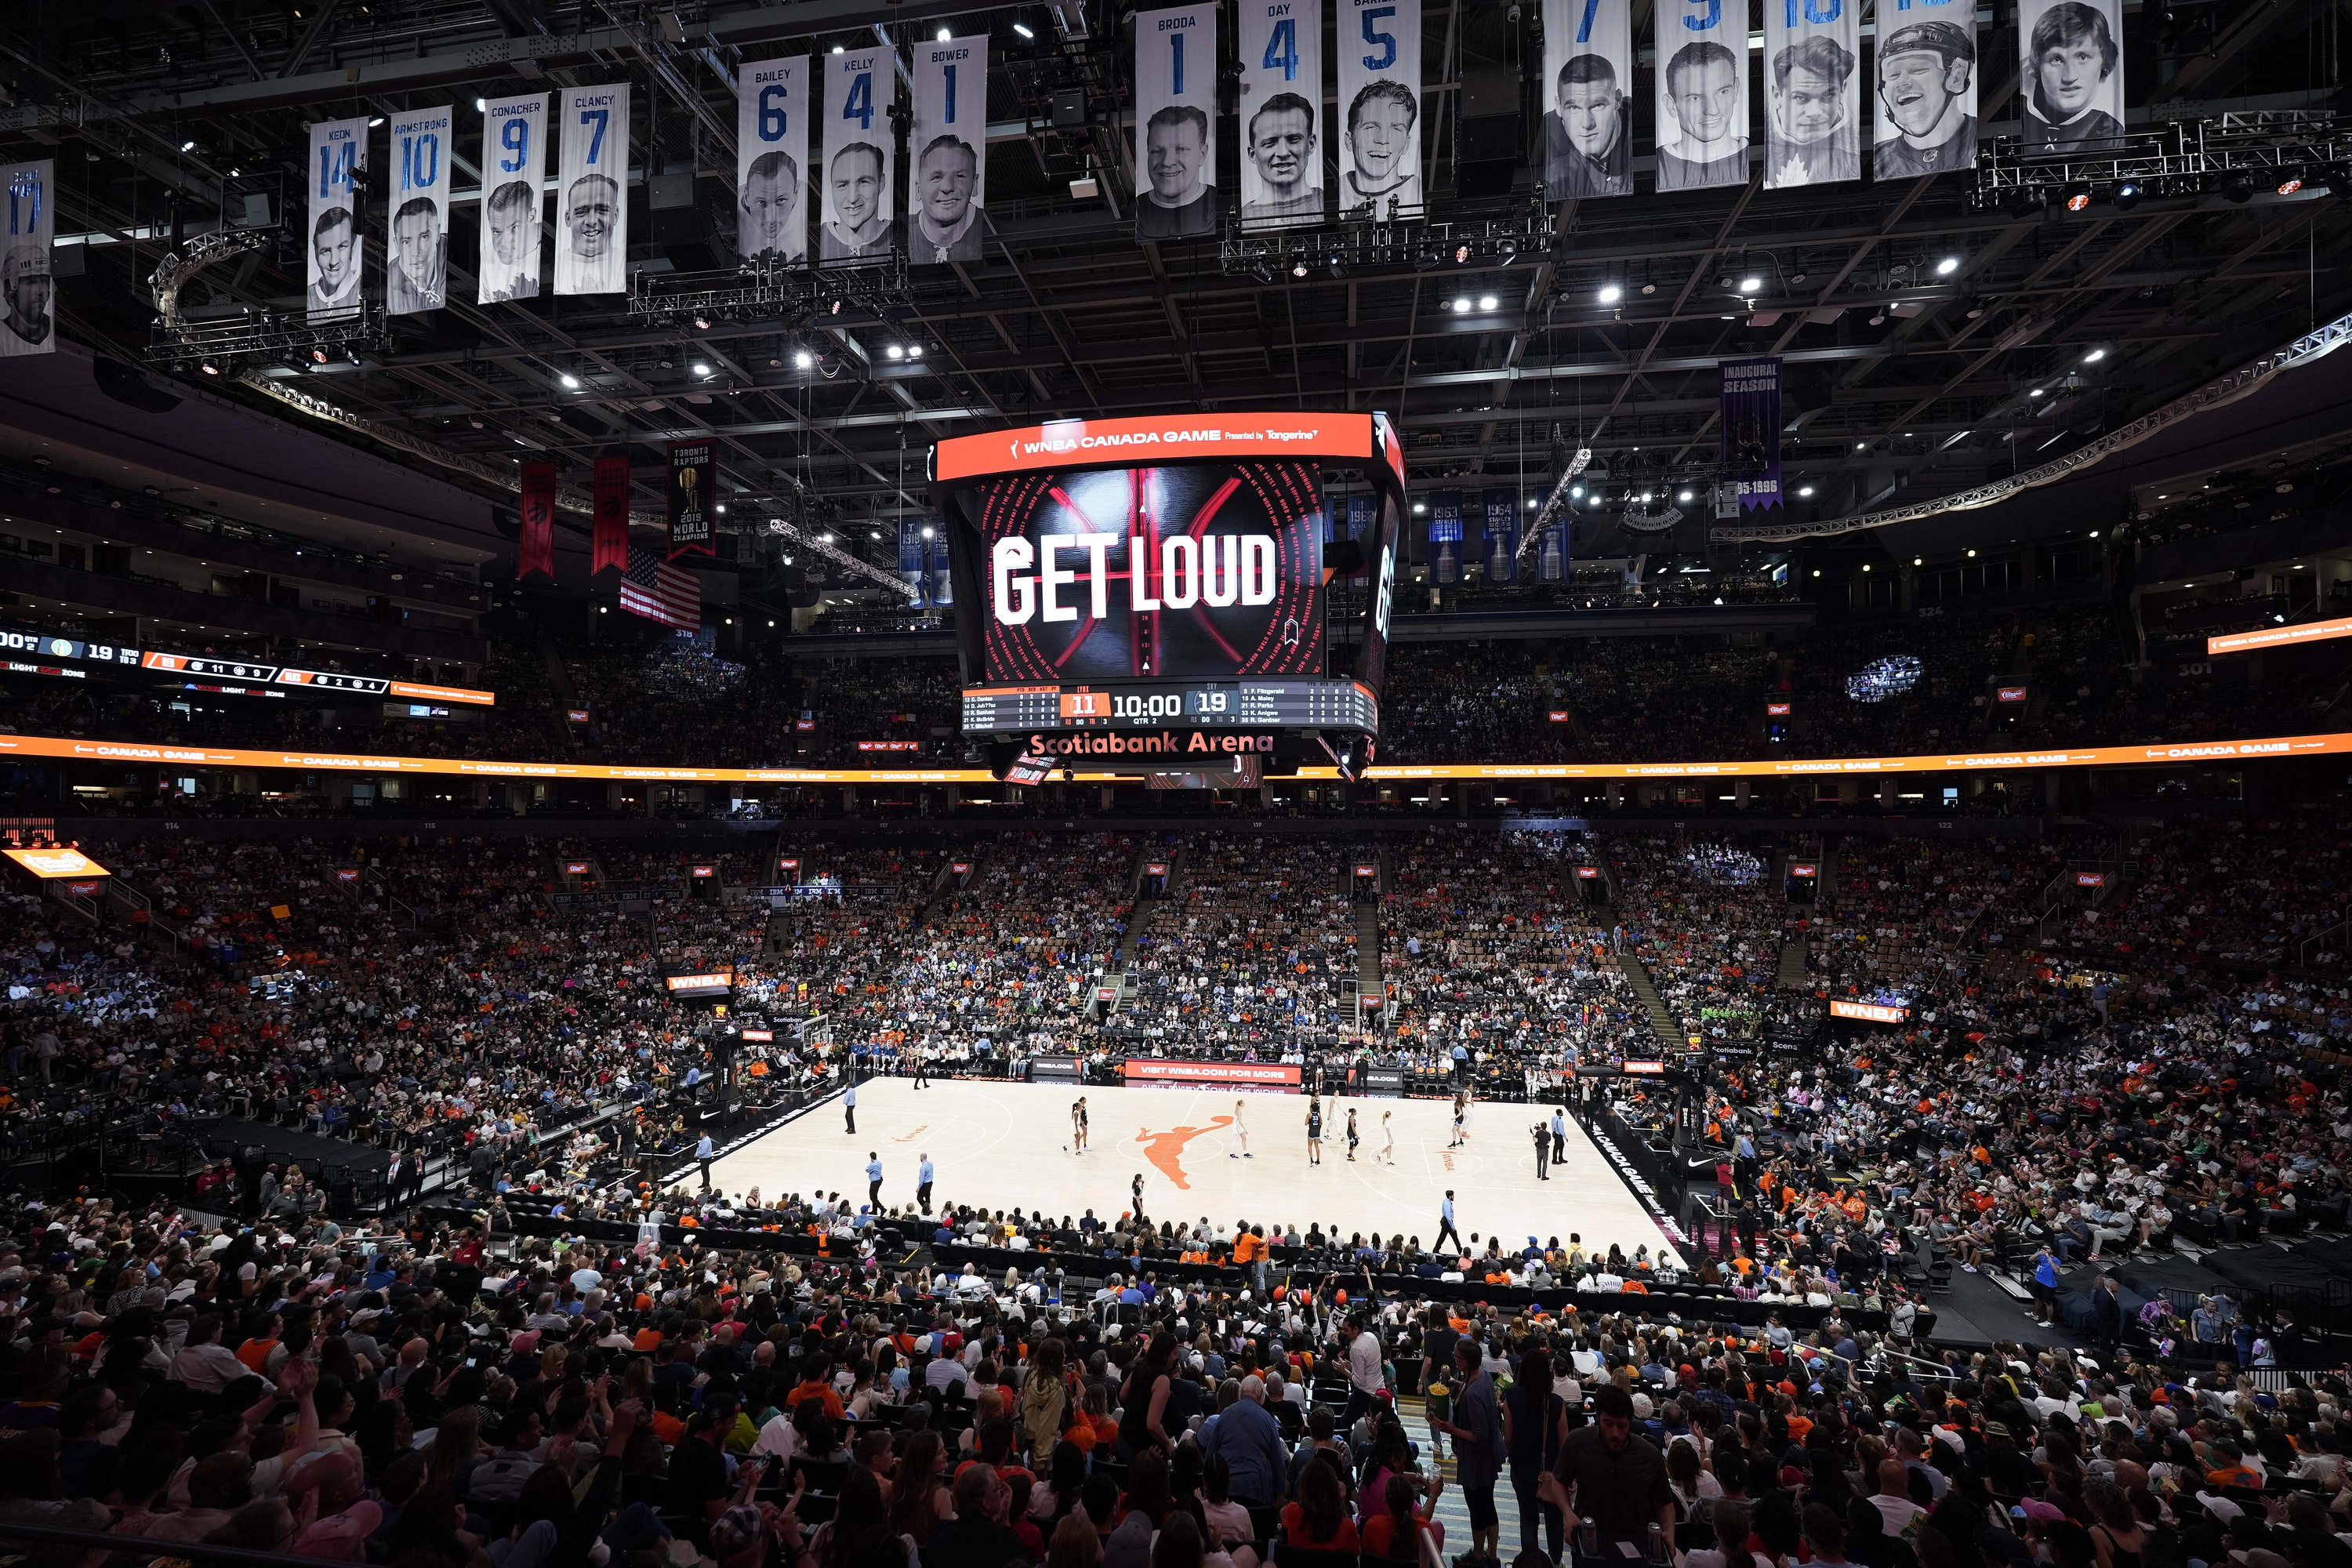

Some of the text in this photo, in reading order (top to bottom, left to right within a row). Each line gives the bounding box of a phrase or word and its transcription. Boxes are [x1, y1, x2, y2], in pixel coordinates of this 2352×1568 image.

[1268, 4, 1291, 18] DAY
[1158, 16, 1196, 31] BRODA
[1362, 6, 1396, 71] 5
[931, 49, 969, 63] BOWER
[1262, 18, 1299, 82] 4
[844, 57, 874, 72] KELLY
[1171, 33, 1184, 95] 1
[756, 69, 791, 83] BAILEY
[575, 94, 615, 108] CLANCY
[843, 72, 873, 130] 4
[943, 64, 956, 124] 1
[492, 102, 541, 118] CONACHER
[758, 84, 787, 142] 6
[394, 118, 448, 135] ARMSTRONG
[328, 129, 350, 141] KEON
[580, 109, 609, 165] 7
[500, 118, 528, 172] 9
[320, 141, 356, 198] 14
[401, 133, 439, 191] 10
[9, 181, 42, 235] 17
[1724, 364, 1777, 379] INAUGURAL
[1724, 379, 1777, 393] SEASON
[1024, 430, 1313, 454] WNBA CANADA GAME Presented by Tangerine
[674, 447, 708, 457] TORONTO
[673, 456, 709, 466] RAPTORS
[1434, 506, 1457, 519] 1963
[1487, 503, 1512, 516] 1964
[681, 513, 702, 523] 2019
[673, 521, 708, 535] WORLD
[673, 532, 709, 542] CHAMPIONS
[993, 532, 1119, 626] GET
[1130, 534, 1276, 612] LOUD
[2219, 628, 2322, 648] WNBA CANADA GAME
[89, 644, 113, 660] 19
[9, 662, 86, 678] LIGHT ZONE
[212, 664, 223, 673] 11
[2178, 662, 2212, 677] 301
[1073, 695, 1095, 714] 11
[1114, 695, 1181, 717] 10:00
[1199, 693, 1226, 712] 19
[1030, 731, 1273, 755] Scotiabank Arena
[2168, 743, 2290, 757] CANADA GAME
[96, 746, 205, 761] CANADA GAME
[1965, 754, 2068, 767] CANADA GAME
[303, 757, 400, 768] CANADA GAME
[475, 764, 557, 775] CANADA GAME
[1791, 763, 1842, 771] CANADA
[1537, 767, 1566, 775] GAME
[672, 975, 727, 989] WNBA
[798, 990, 808, 1002] 24
[1836, 1004, 1904, 1022] WNBA
[1712, 1046, 1754, 1054] Scotiabank.
[1141, 1066, 1286, 1079] VISIT WNBA.COM FOR MORE
[711, 1109, 803, 1158] CANADA GAME
[1442, 1153, 1456, 1171] WNBA
[1596, 1136, 1632, 1167] CANADA
[1621, 1167, 1654, 1195] GAME
